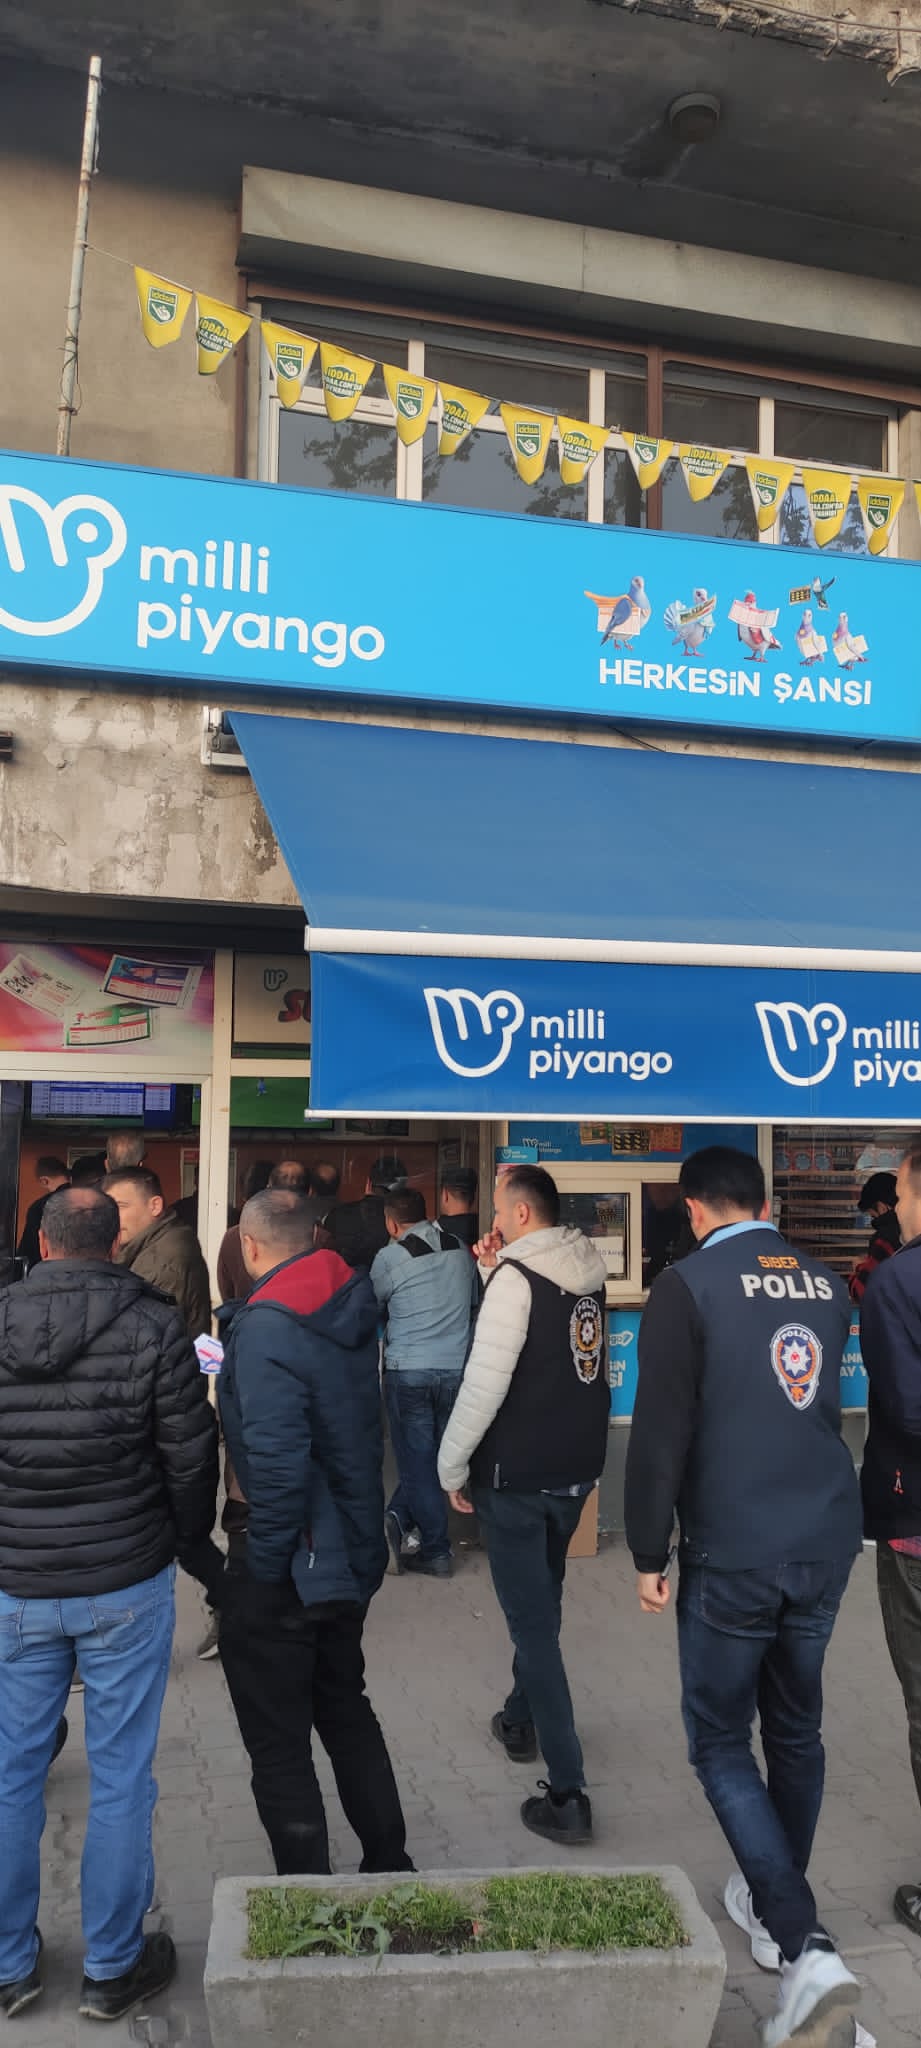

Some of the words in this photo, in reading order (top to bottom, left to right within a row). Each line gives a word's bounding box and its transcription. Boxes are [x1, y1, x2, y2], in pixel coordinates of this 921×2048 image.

[139, 540, 270, 594] milli
[137, 593, 385, 668] piyango
[773, 672, 872, 706] ŞANSI
[531, 1008, 605, 1040] milli
[852, 1020, 920, 1049] milli
[529, 1042, 673, 1081] piyango
[853, 1052, 921, 1088] piya
[741, 1270, 833, 1300] POLİS
